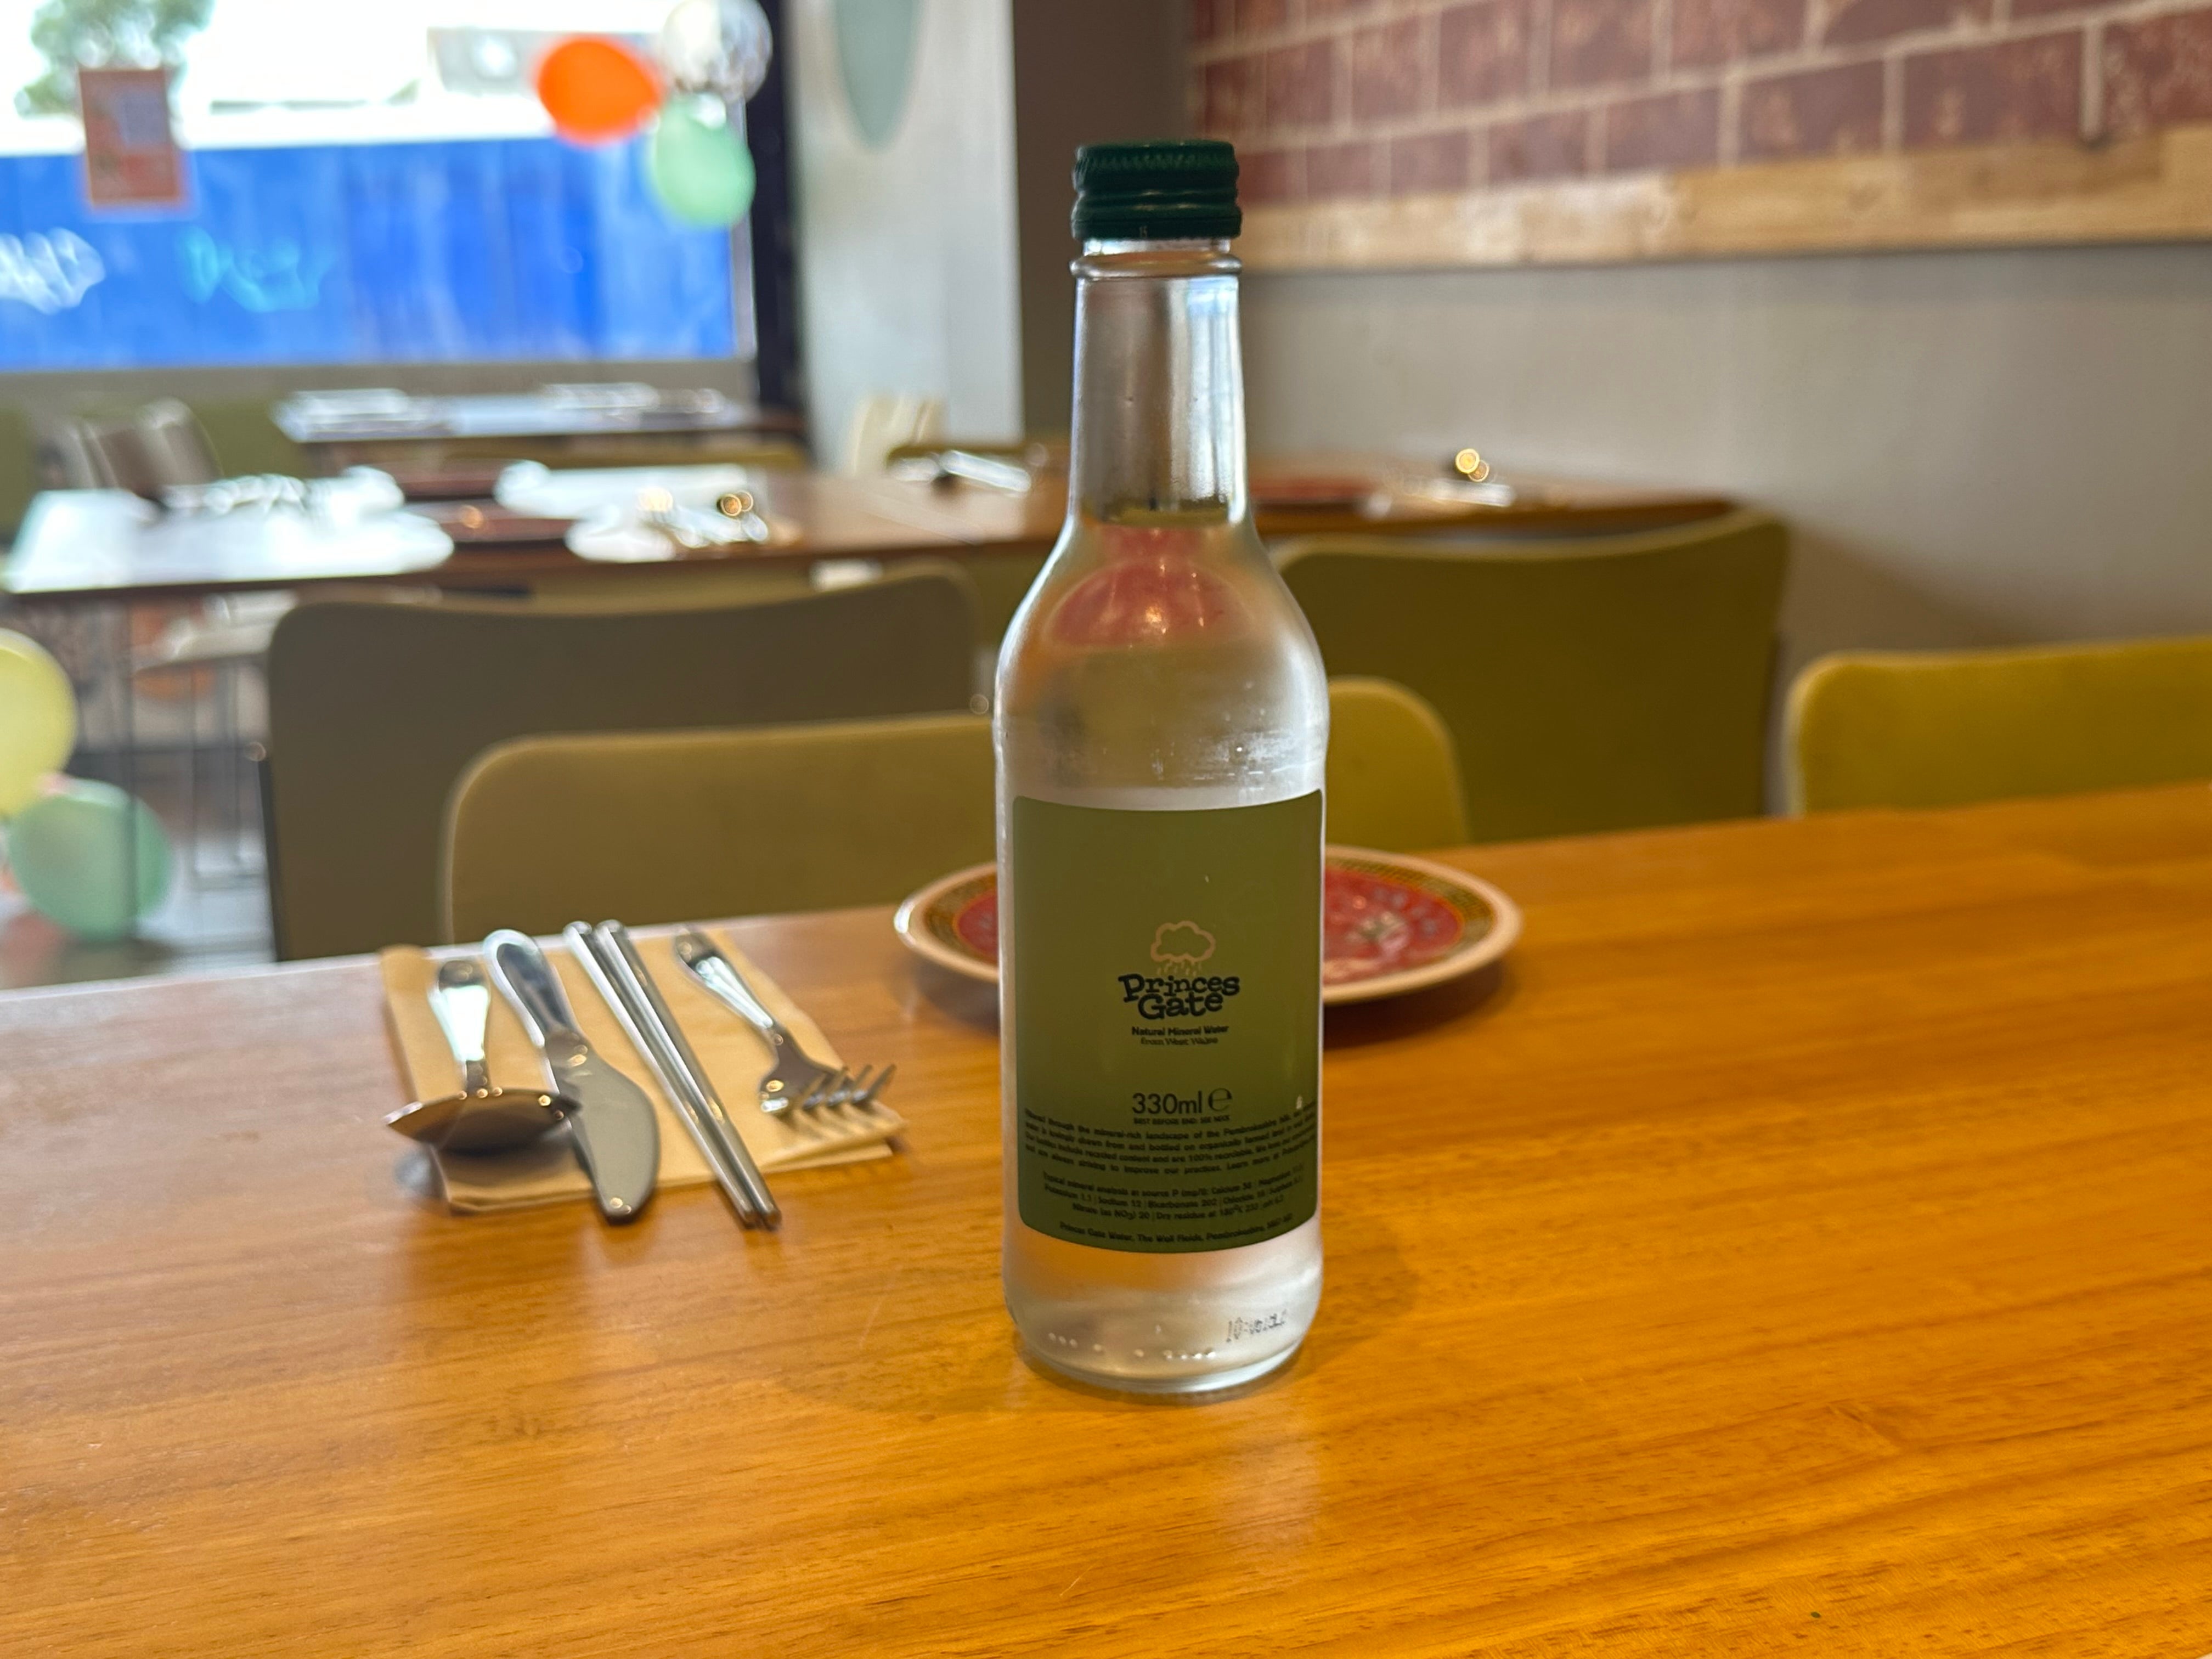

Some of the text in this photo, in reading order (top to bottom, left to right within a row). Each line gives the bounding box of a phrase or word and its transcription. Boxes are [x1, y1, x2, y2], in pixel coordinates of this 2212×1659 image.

[1118, 973, 1240, 1002] Princes
[1138, 990, 1224, 1019] Gate
[1131, 1024, 1229, 1036] Natural Mineral Water
[1141, 1036, 1164, 1045] from
[1132, 1091, 1203, 1114] 330ml
[1048, 1118, 1075, 1130] through
[1078, 1125, 1090, 1133] the
[1094, 1128, 1141, 1139] mineral-rich
[1146, 1131, 1189, 1140] landscape
[1194, 1130, 1202, 1138] of
[1223, 1120, 1277, 1136] Pembrokeshire
[1078, 1136, 1102, 1146] drawn
[1106, 1140, 1125, 1149] from
[1199, 1138, 1241, 1150] organically
[1244, 1131, 1269, 1143] farmed
[1058, 1143, 1082, 1155] include
[1085, 1150, 1118, 1160] recycled
[1188, 1154, 1213, 1162] 100%
[1079, 1159, 1105, 1171] striving
[1124, 1165, 1159, 1174] improve
[1227, 1161, 1249, 1170] Learn
[1252, 1156, 1270, 1165] more
[1067, 1180, 1094, 1191] mineral
[1097, 1187, 1128, 1195] analysis
[1211, 1185, 1240, 1194] Calcium
[1073, 1202, 1098, 1214] Nitrate
[1138, 1211, 1150, 1220] 20
[1156, 1211, 1171, 1220] Dry
[1174, 1211, 1205, 1220] residue
[1098, 1196, 1128, 1206] Sodium
[1148, 1200, 1198, 1209] Bicarbonate
[1059, 1221, 1086, 1234] Princes
[1087, 1227, 1105, 1238] Gate
[1137, 1233, 1153, 1243] The
